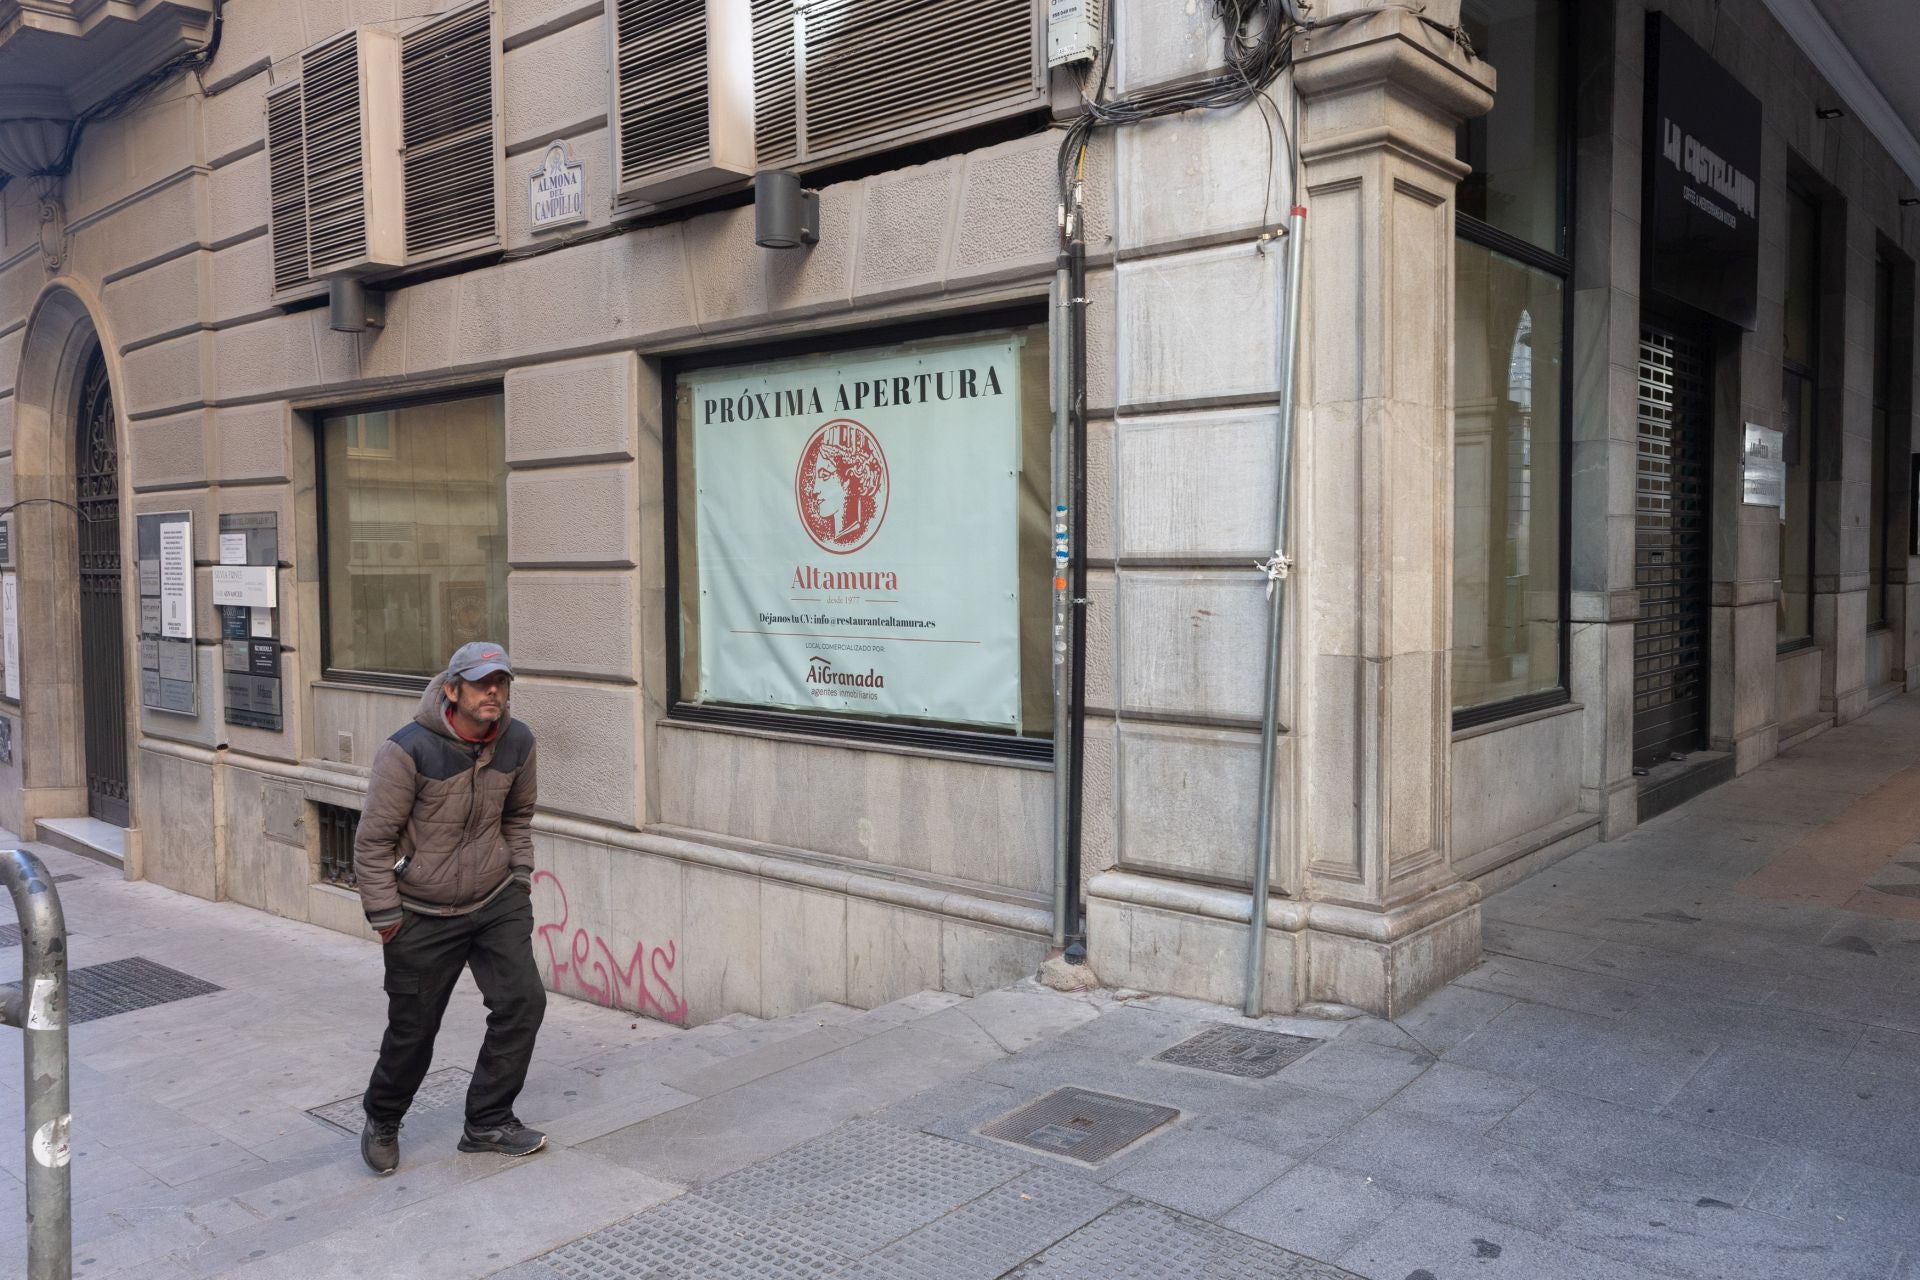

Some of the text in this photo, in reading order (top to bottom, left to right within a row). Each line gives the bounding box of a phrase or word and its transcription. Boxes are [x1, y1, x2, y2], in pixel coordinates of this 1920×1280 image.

[1663, 117, 1681, 172] LA
[538, 172, 577, 193] ALMONA
[549, 188, 564, 199] DEL
[534, 192, 580, 221] CAMPILLO
[704, 365, 1004, 425] PRÓXIMA APERTURA
[791, 565, 898, 591] Altamura
[759, 612, 792, 626] Déjanos
[805, 642, 822, 650] LOCAL
[821, 643, 872, 653] COMERCIALIZADO
[805, 664, 885, 689] AiGranada
[811, 687, 879, 701] agentes inmobiliarios
